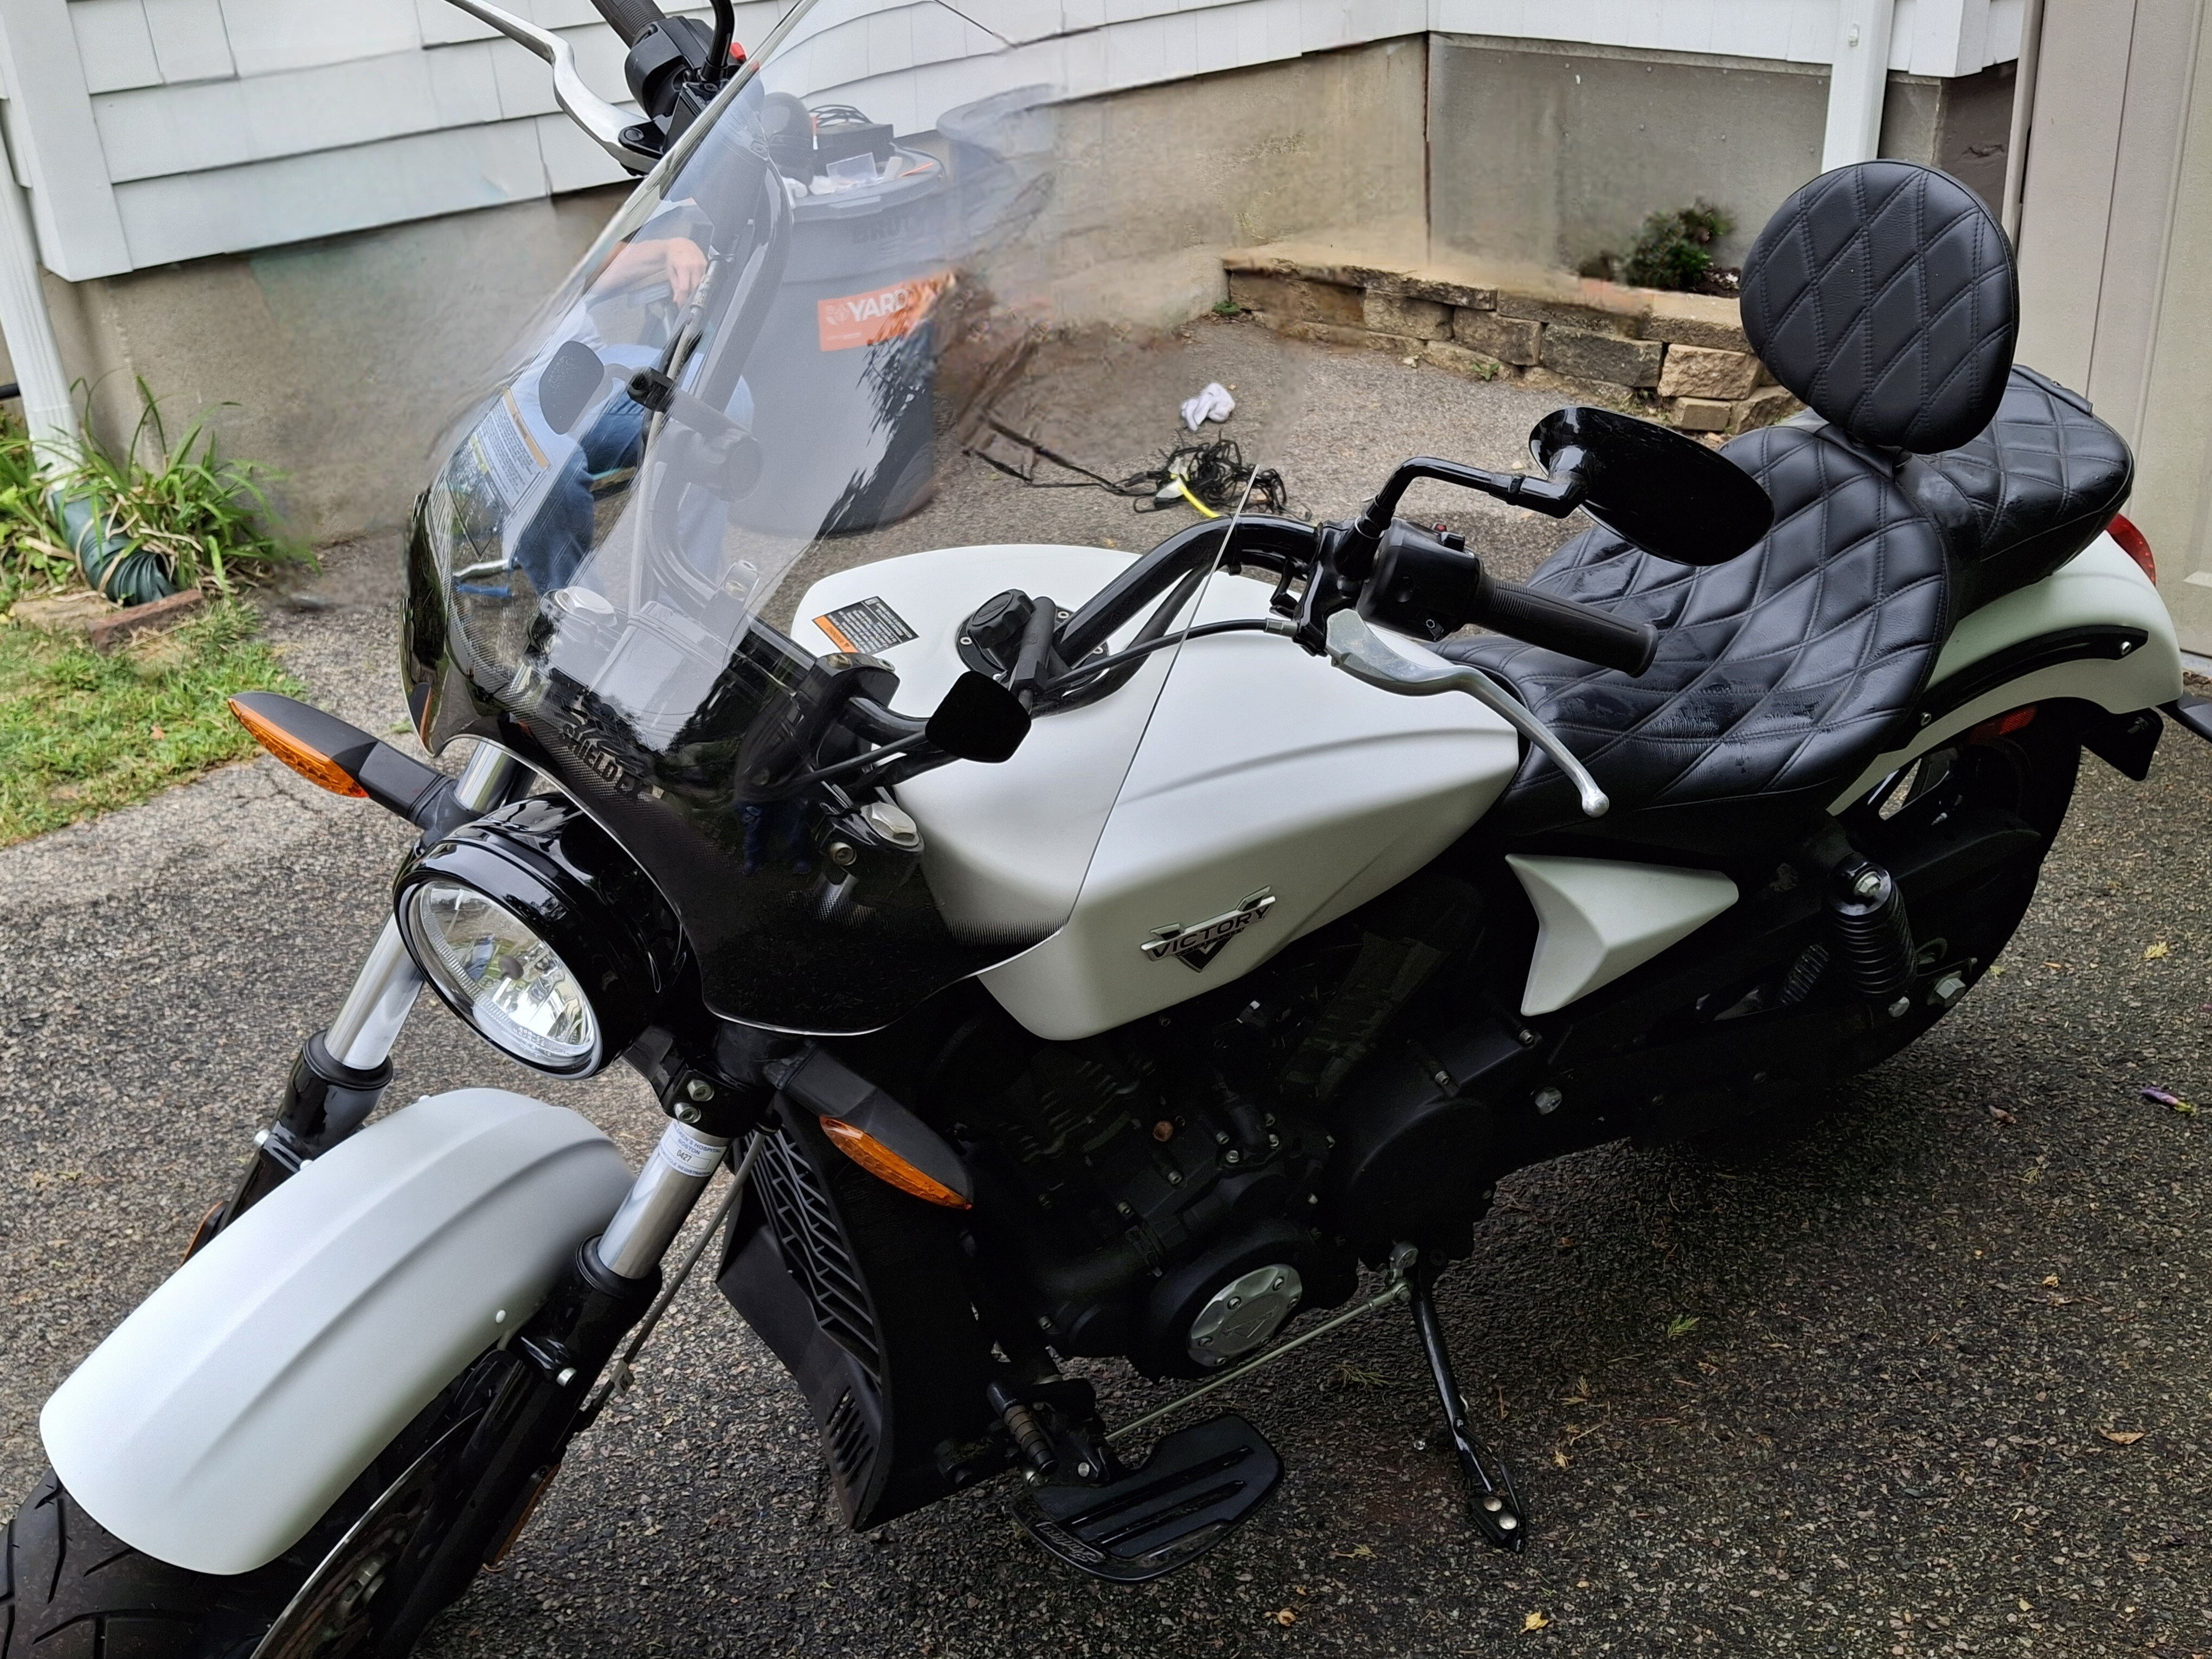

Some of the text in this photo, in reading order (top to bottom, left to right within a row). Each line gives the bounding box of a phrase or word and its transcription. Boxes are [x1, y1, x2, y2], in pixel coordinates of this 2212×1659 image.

[1152, 905, 1271, 958] VICTORY
[678, 1139, 700, 1155] BOSTON
[677, 1149, 692, 1162] 0427
